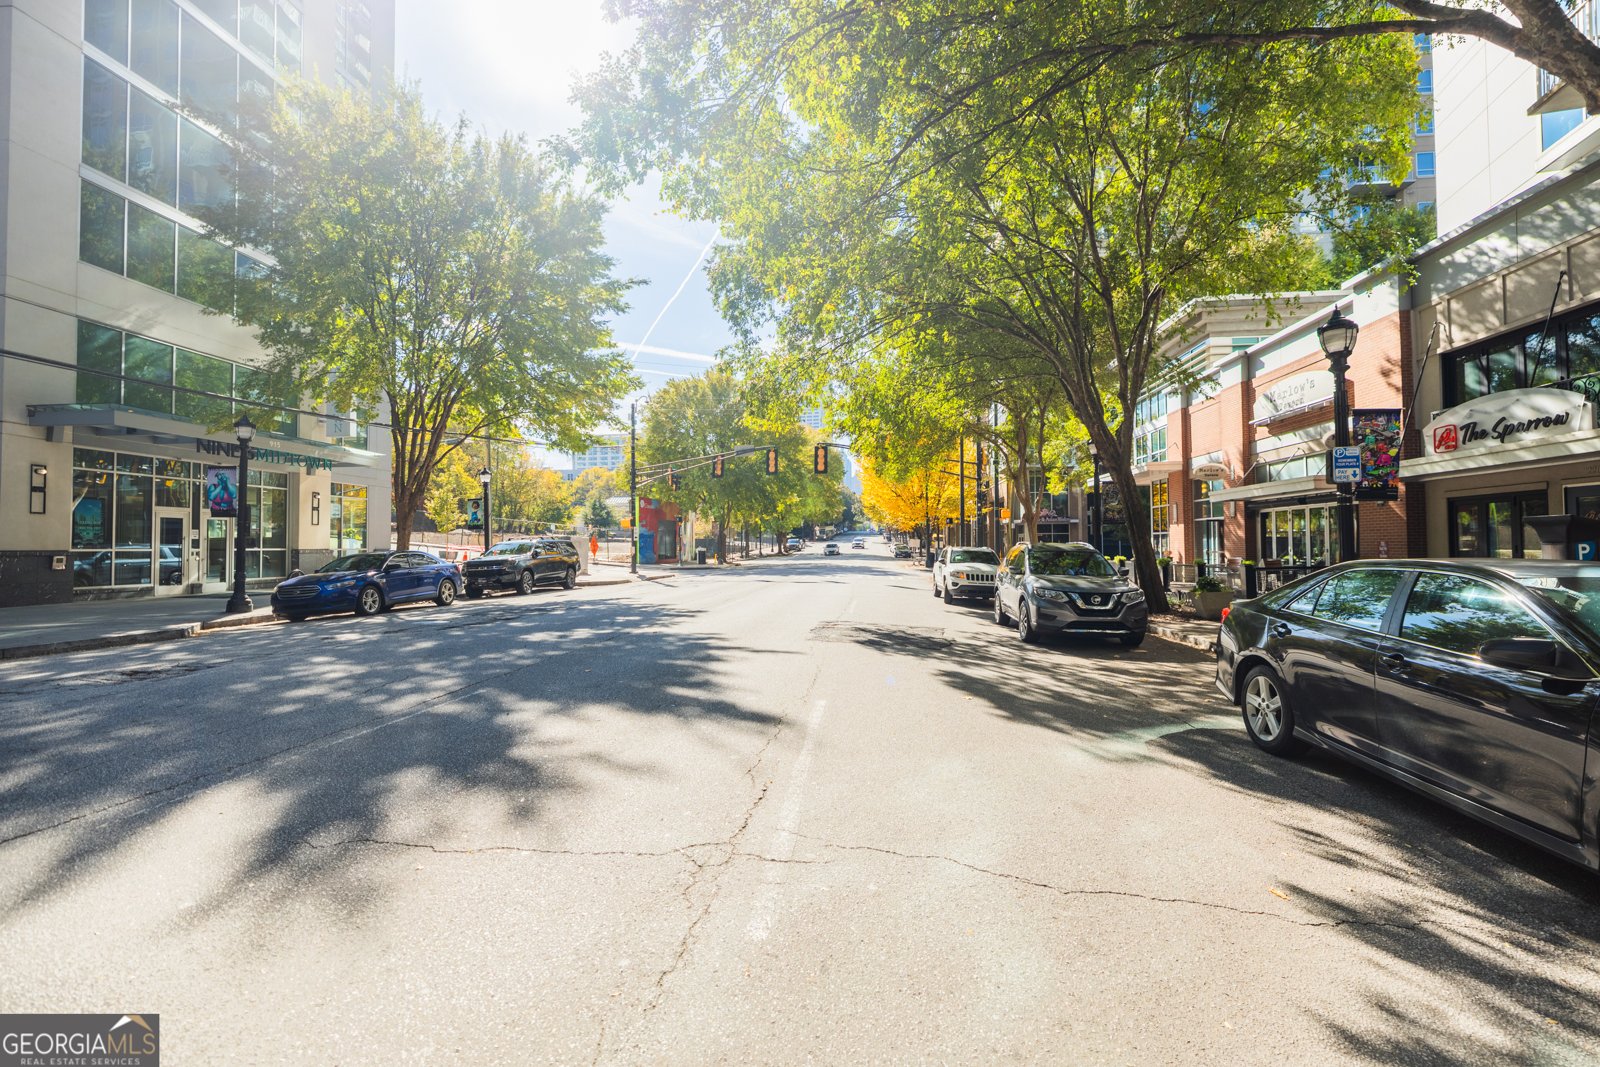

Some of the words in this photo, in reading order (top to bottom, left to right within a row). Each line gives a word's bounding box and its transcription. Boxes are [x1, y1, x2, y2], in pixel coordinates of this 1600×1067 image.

[1460, 421, 1488, 445] The
[1491, 411, 1569, 443] Sparrow
[256, 447, 332, 472] MIDTOWN
[1578, 543, 1591, 560] P
